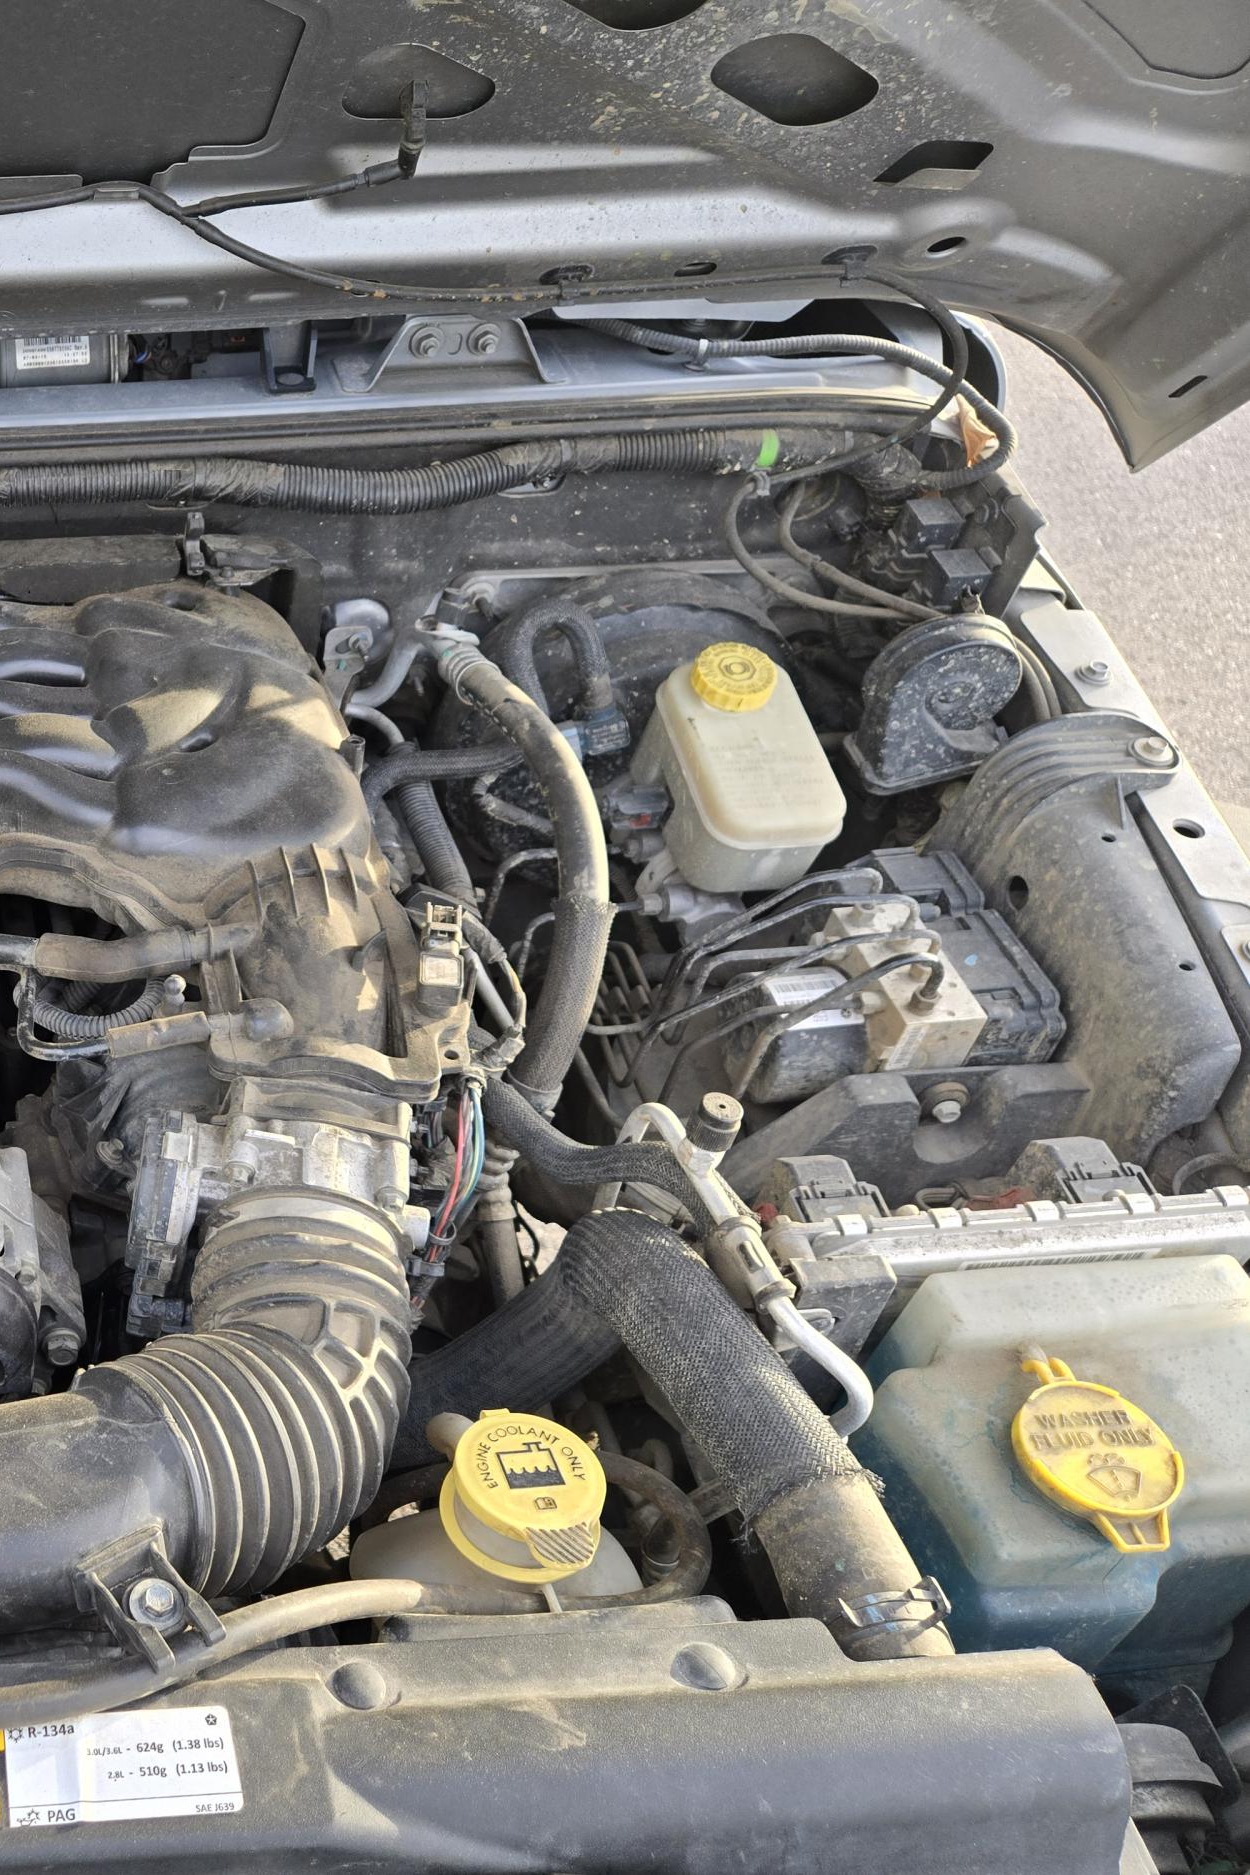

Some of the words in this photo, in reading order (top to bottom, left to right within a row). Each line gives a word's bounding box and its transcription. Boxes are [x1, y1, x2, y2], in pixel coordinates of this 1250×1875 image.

[1033, 1409, 1132, 1430] WASHER
[487, 1425, 560, 1445] COOLANT
[1030, 1432, 1094, 1450] FLUID
[1100, 1428, 1156, 1447] ONLY
[476, 1442, 499, 1490] ENGINE
[561, 1446, 586, 1481] ONLY
[28, 1724, 75, 1738] R-134a
[136, 1742, 164, 1754] 624g
[172, 1739, 201, 1752] (1.38
[203, 1737, 224, 1750] lbs)
[107, 1770, 125, 1780] 2.8L
[139, 1765, 167, 1778] 510g
[176, 1763, 205, 1776] (1.13
[207, 1760, 228, 1774] lbs)
[47, 1808, 76, 1823] PAG
[195, 1804, 212, 1813] SAE
[215, 1802, 235, 1812] J639
